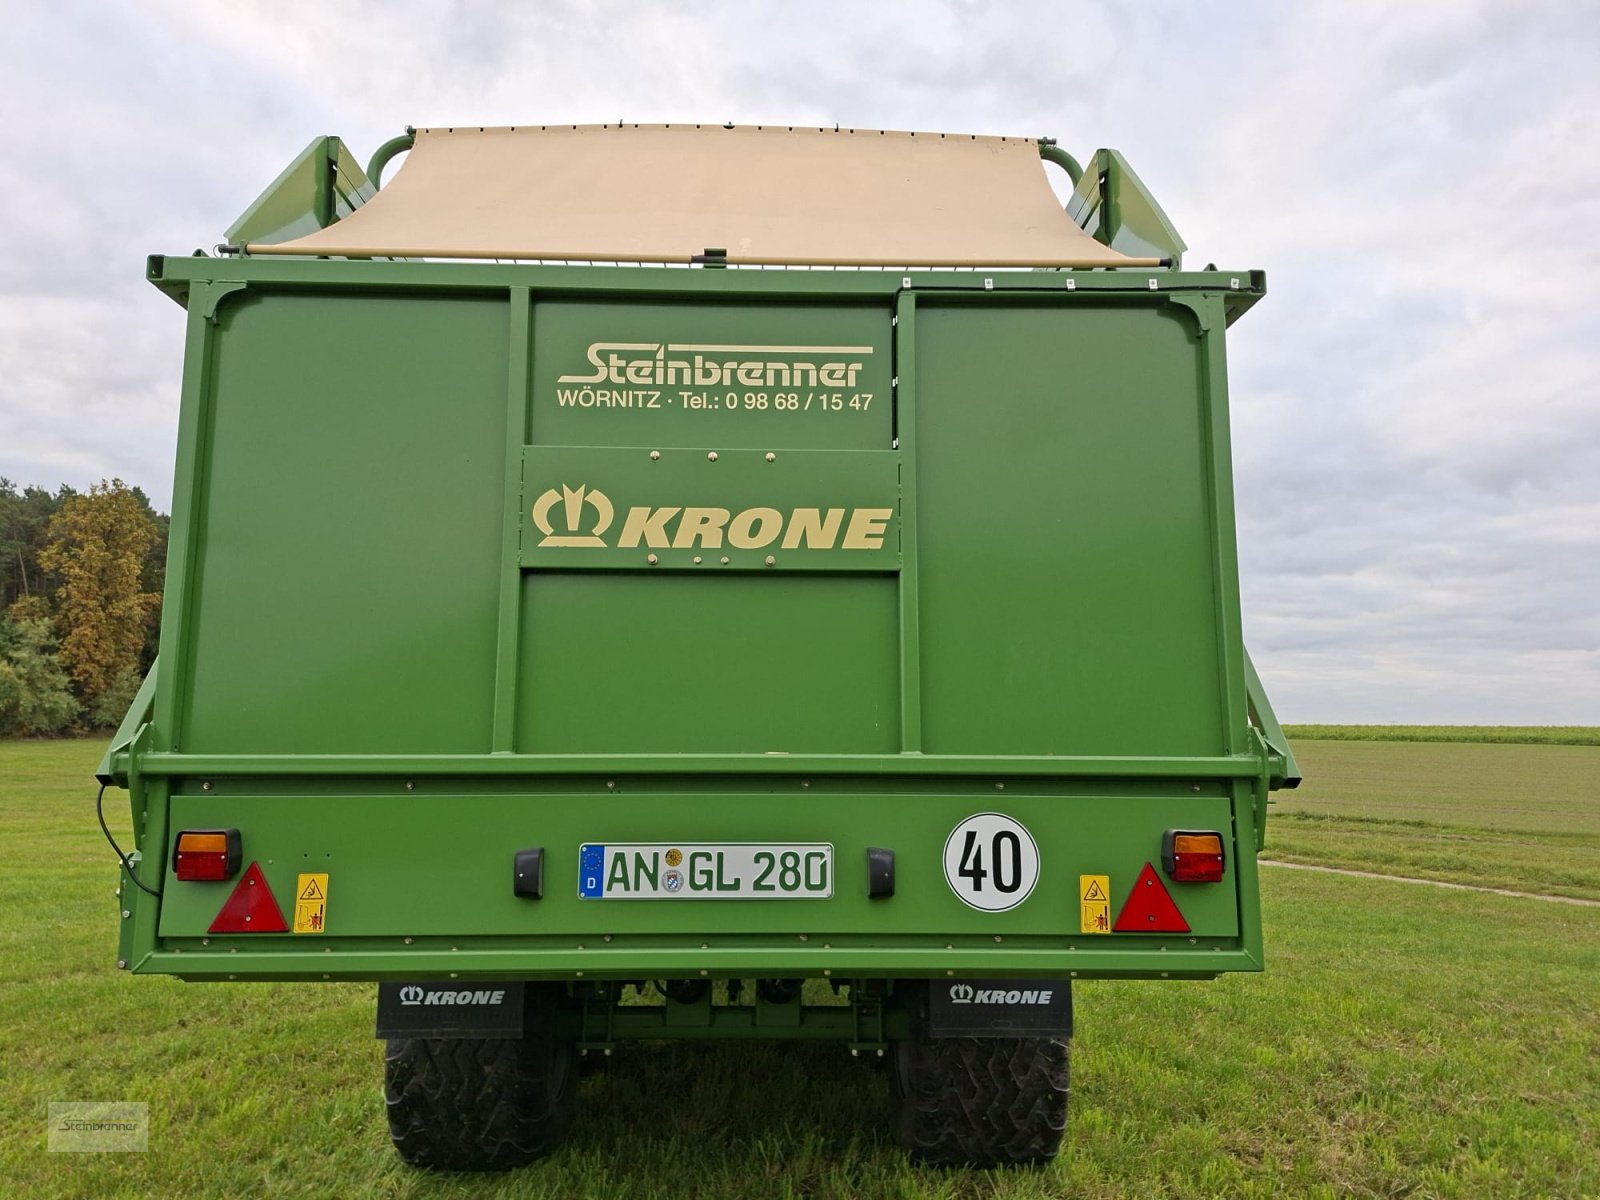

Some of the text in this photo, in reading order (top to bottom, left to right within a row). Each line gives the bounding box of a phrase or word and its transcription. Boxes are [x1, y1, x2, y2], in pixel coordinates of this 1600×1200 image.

[557, 342, 865, 387] Steinbrenner
[557, 386, 661, 408] WÖRNITZ
[679, 392, 719, 409] Tel.:
[726, 392, 738, 409] 0
[744, 393, 768, 410] 98
[774, 393, 799, 410] 68
[819, 394, 843, 410] 15
[849, 394, 873, 410] 47
[617, 507, 893, 549] KRONE
[606, 851, 828, 892] AN GL 280
[958, 831, 1023, 893] 40
[587, 877, 596, 889] D
[423, 991, 505, 1004] KRONE
[974, 990, 1053, 1004] KRONE
